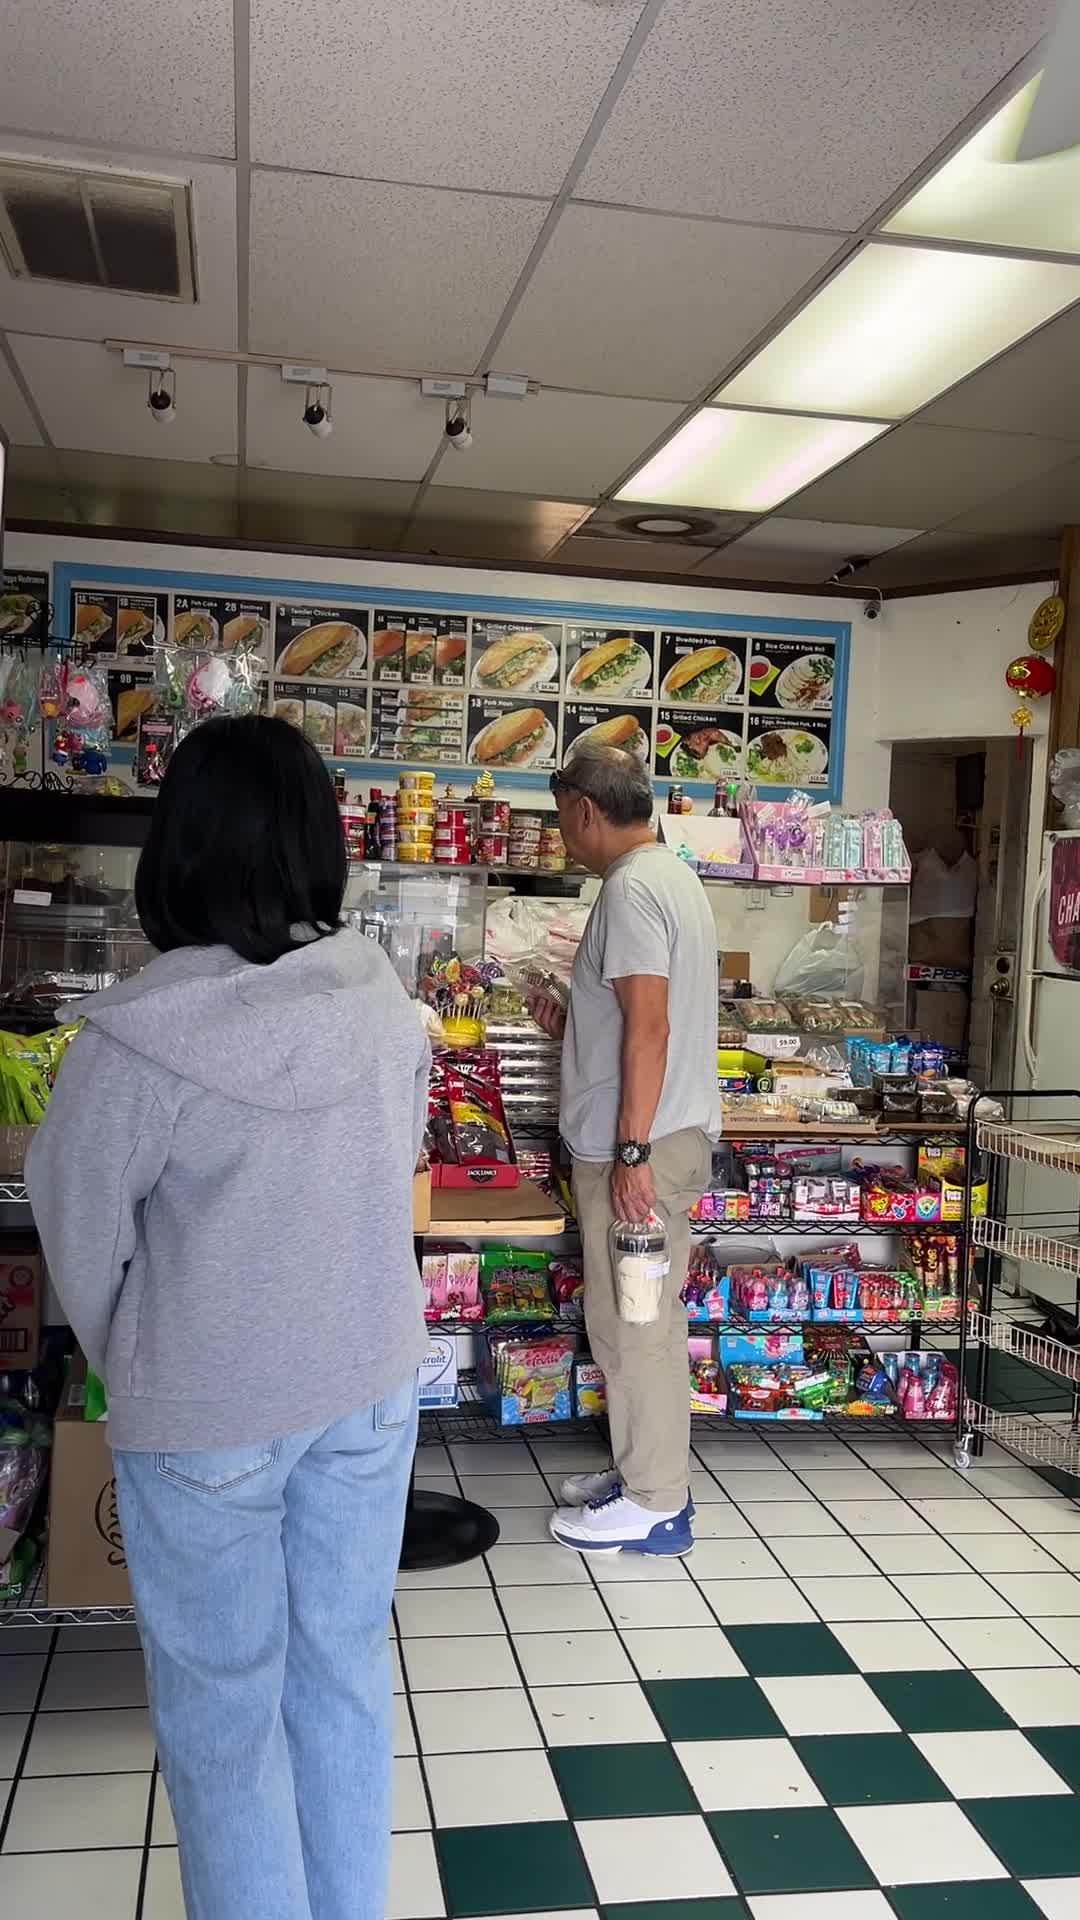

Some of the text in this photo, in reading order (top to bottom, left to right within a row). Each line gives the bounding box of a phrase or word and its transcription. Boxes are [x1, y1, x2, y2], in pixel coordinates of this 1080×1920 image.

[176, 598, 188, 609] 2A
[224, 602, 237, 612] 2B
[280, 607, 286, 616] 3
[665, 636, 671, 644] 7
[755, 642, 761, 651] 8
[120, 674, 131, 684] 9B
[471, 698, 481, 707] 13
[566, 705, 577, 714] 14
[660, 711, 670, 720] 15
[750, 717, 759, 725] 16
